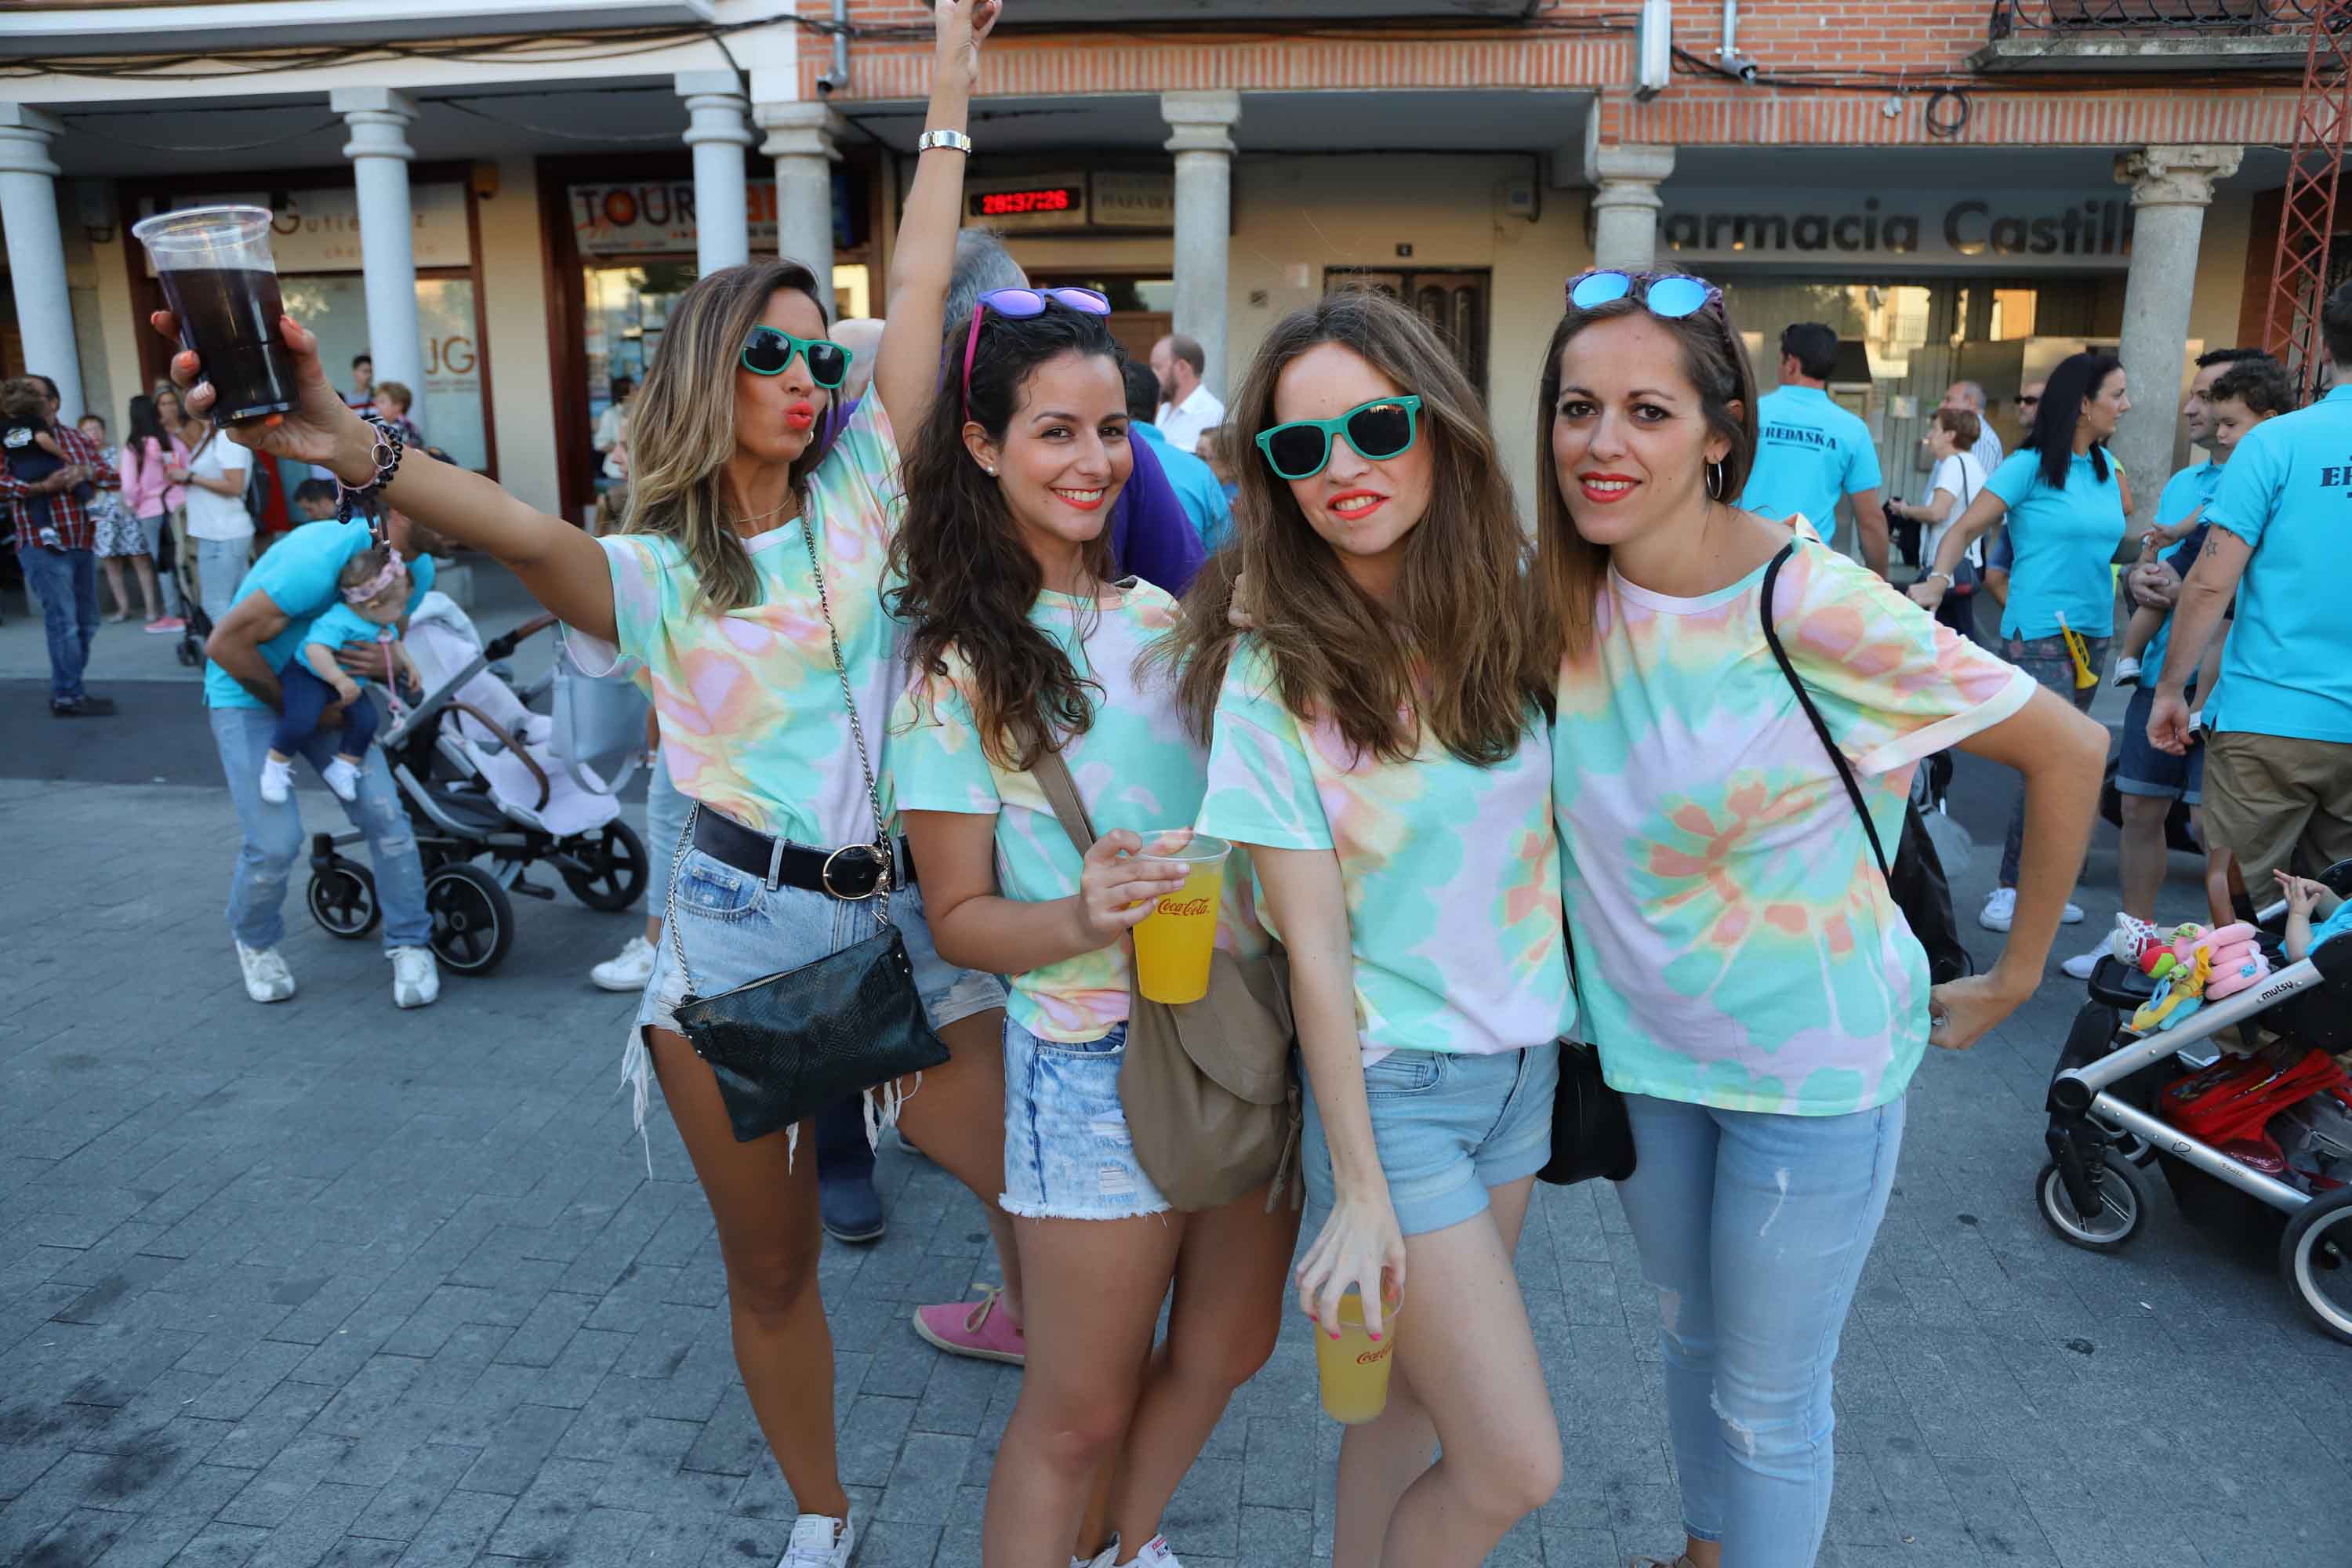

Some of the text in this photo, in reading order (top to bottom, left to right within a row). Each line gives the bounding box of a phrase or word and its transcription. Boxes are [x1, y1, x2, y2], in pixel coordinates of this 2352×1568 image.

[1656, 198, 2133, 255] armacia Castill
[2261, 980, 2294, 1000] mutsy
